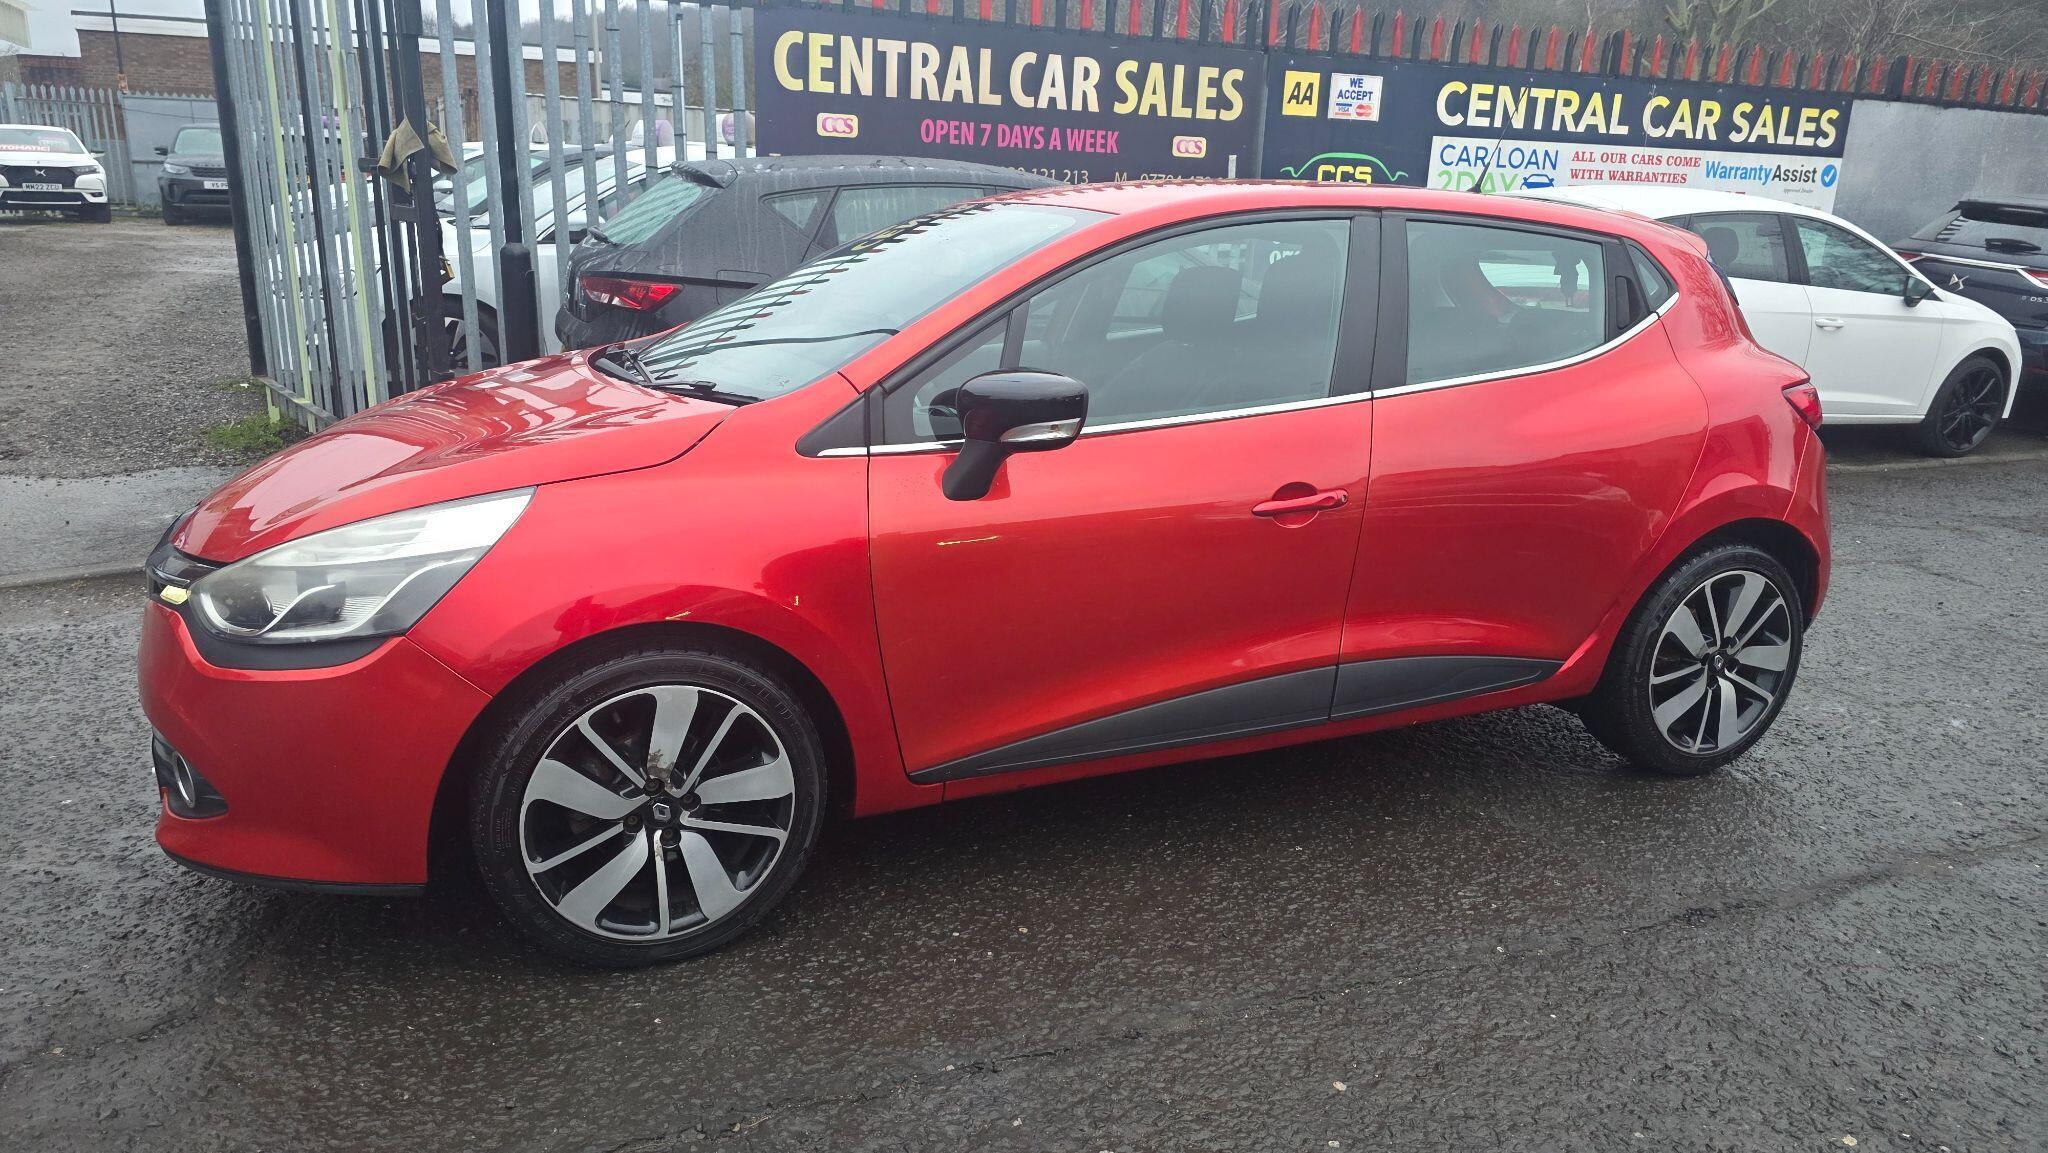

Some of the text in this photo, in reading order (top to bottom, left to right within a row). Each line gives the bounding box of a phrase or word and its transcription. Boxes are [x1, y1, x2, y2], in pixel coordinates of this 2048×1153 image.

[773, 30, 1245, 122] CENTRAL CAR SALES
[1349, 77, 1364, 88] WE
[1286, 81, 1315, 105] AA
[1336, 89, 1374, 101] ACCEPT
[1436, 81, 1840, 148] CENTRAL CAR SALES
[920, 119, 1120, 154] OPEN 7 DAYS A WEEK
[0, 144, 49, 152] TOMATIC
[1440, 144, 1559, 171] CAR LOAN
[1572, 150, 1702, 168] ALL OUR CARS COME
[1063, 169, 1089, 185] 213
[1317, 164, 1372, 185] CCS
[1438, 169, 1519, 193] 2DAY
[1570, 168, 1688, 184] WITH WARRANTIES
[1705, 160, 1818, 186] WarrantyAssist
